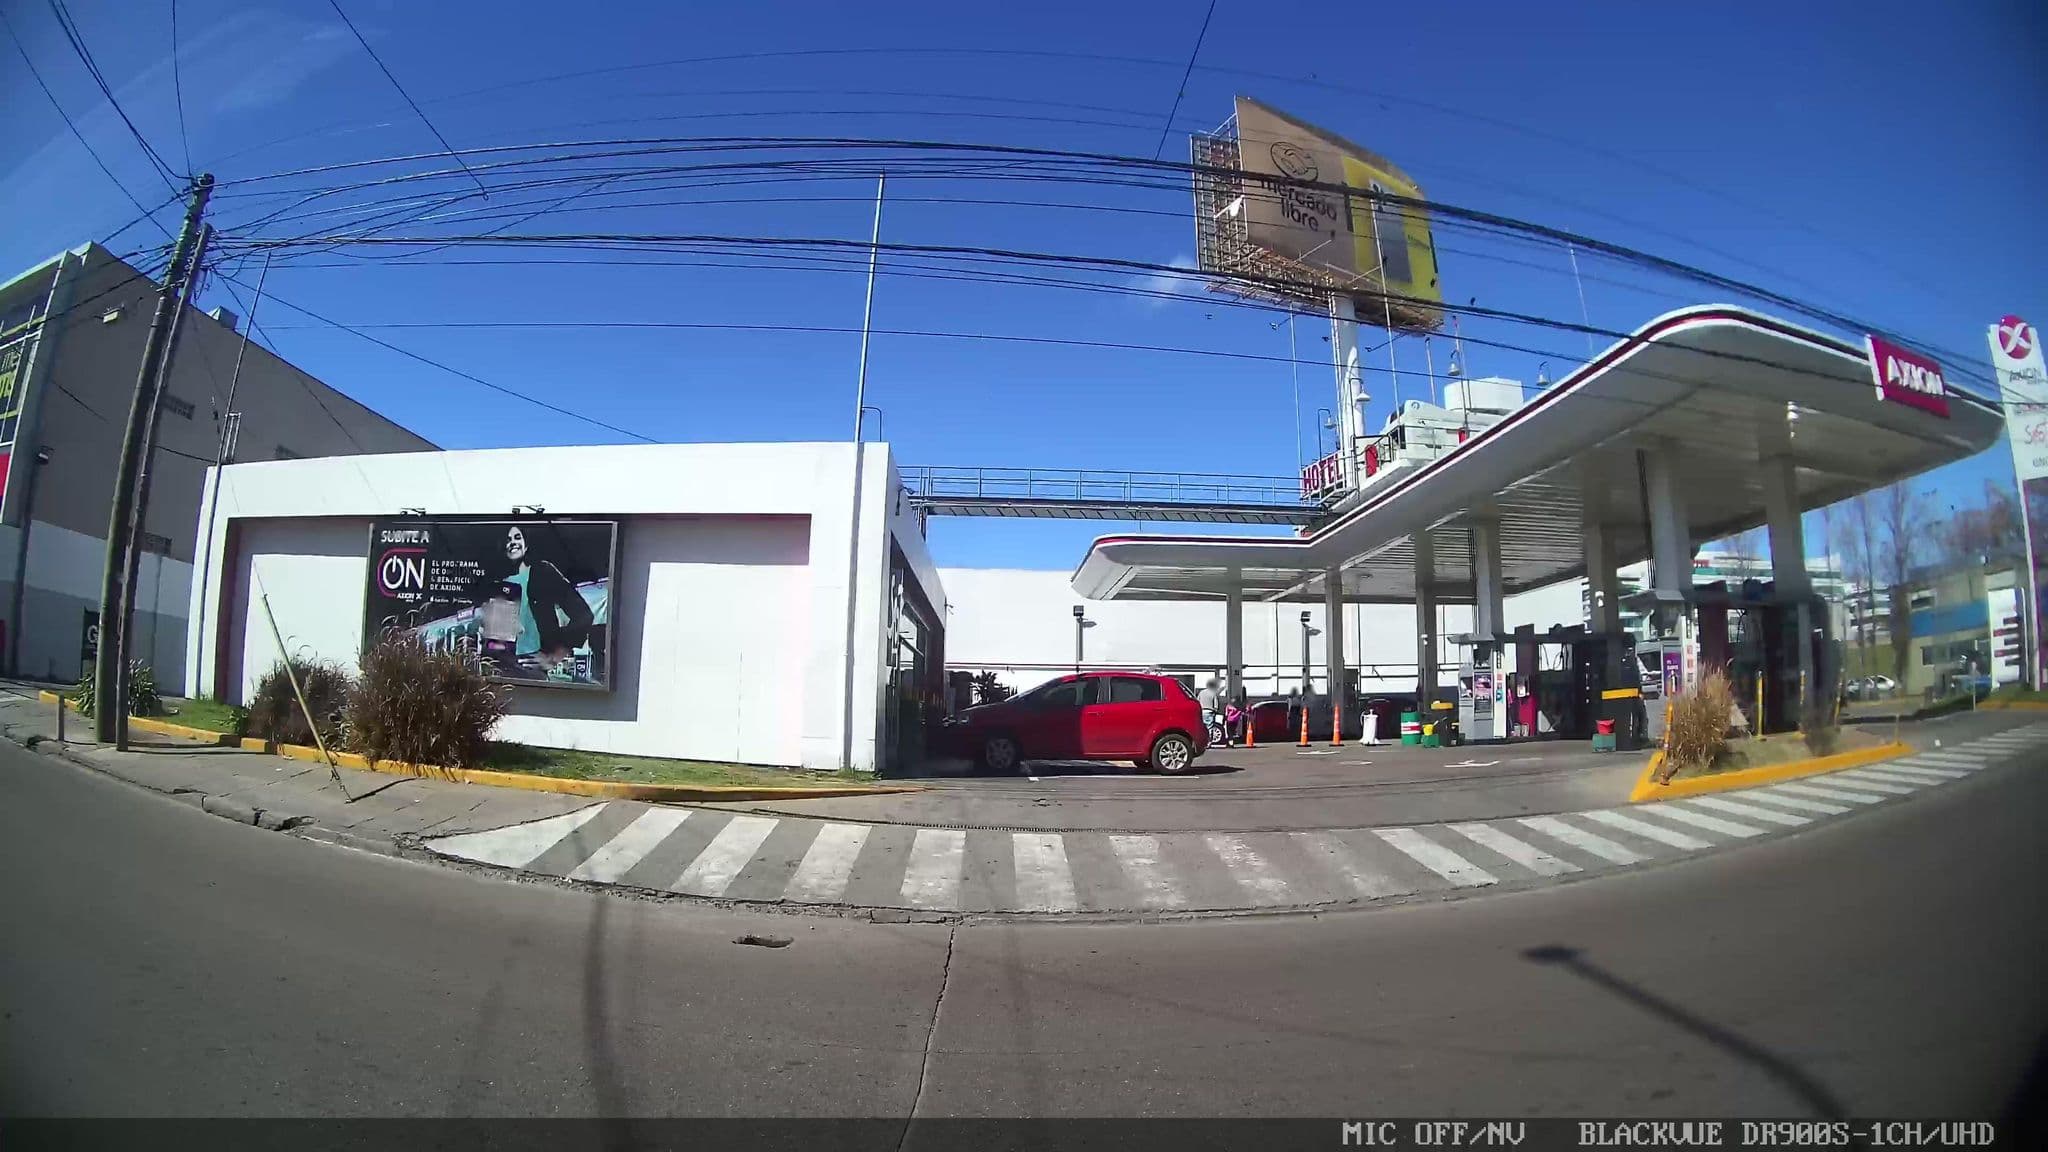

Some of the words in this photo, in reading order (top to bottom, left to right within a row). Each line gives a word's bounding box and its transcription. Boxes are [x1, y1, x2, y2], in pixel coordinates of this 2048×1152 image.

[1280, 198, 1319, 232] libre
[1887, 355, 1945, 396] AXION
[1303, 453, 1343, 494] HOTEL
[381, 530, 419, 544] SUBITE
[420, 530, 430, 544] A
[382, 555, 426, 590] ON
[431, 560, 440, 568] EL
